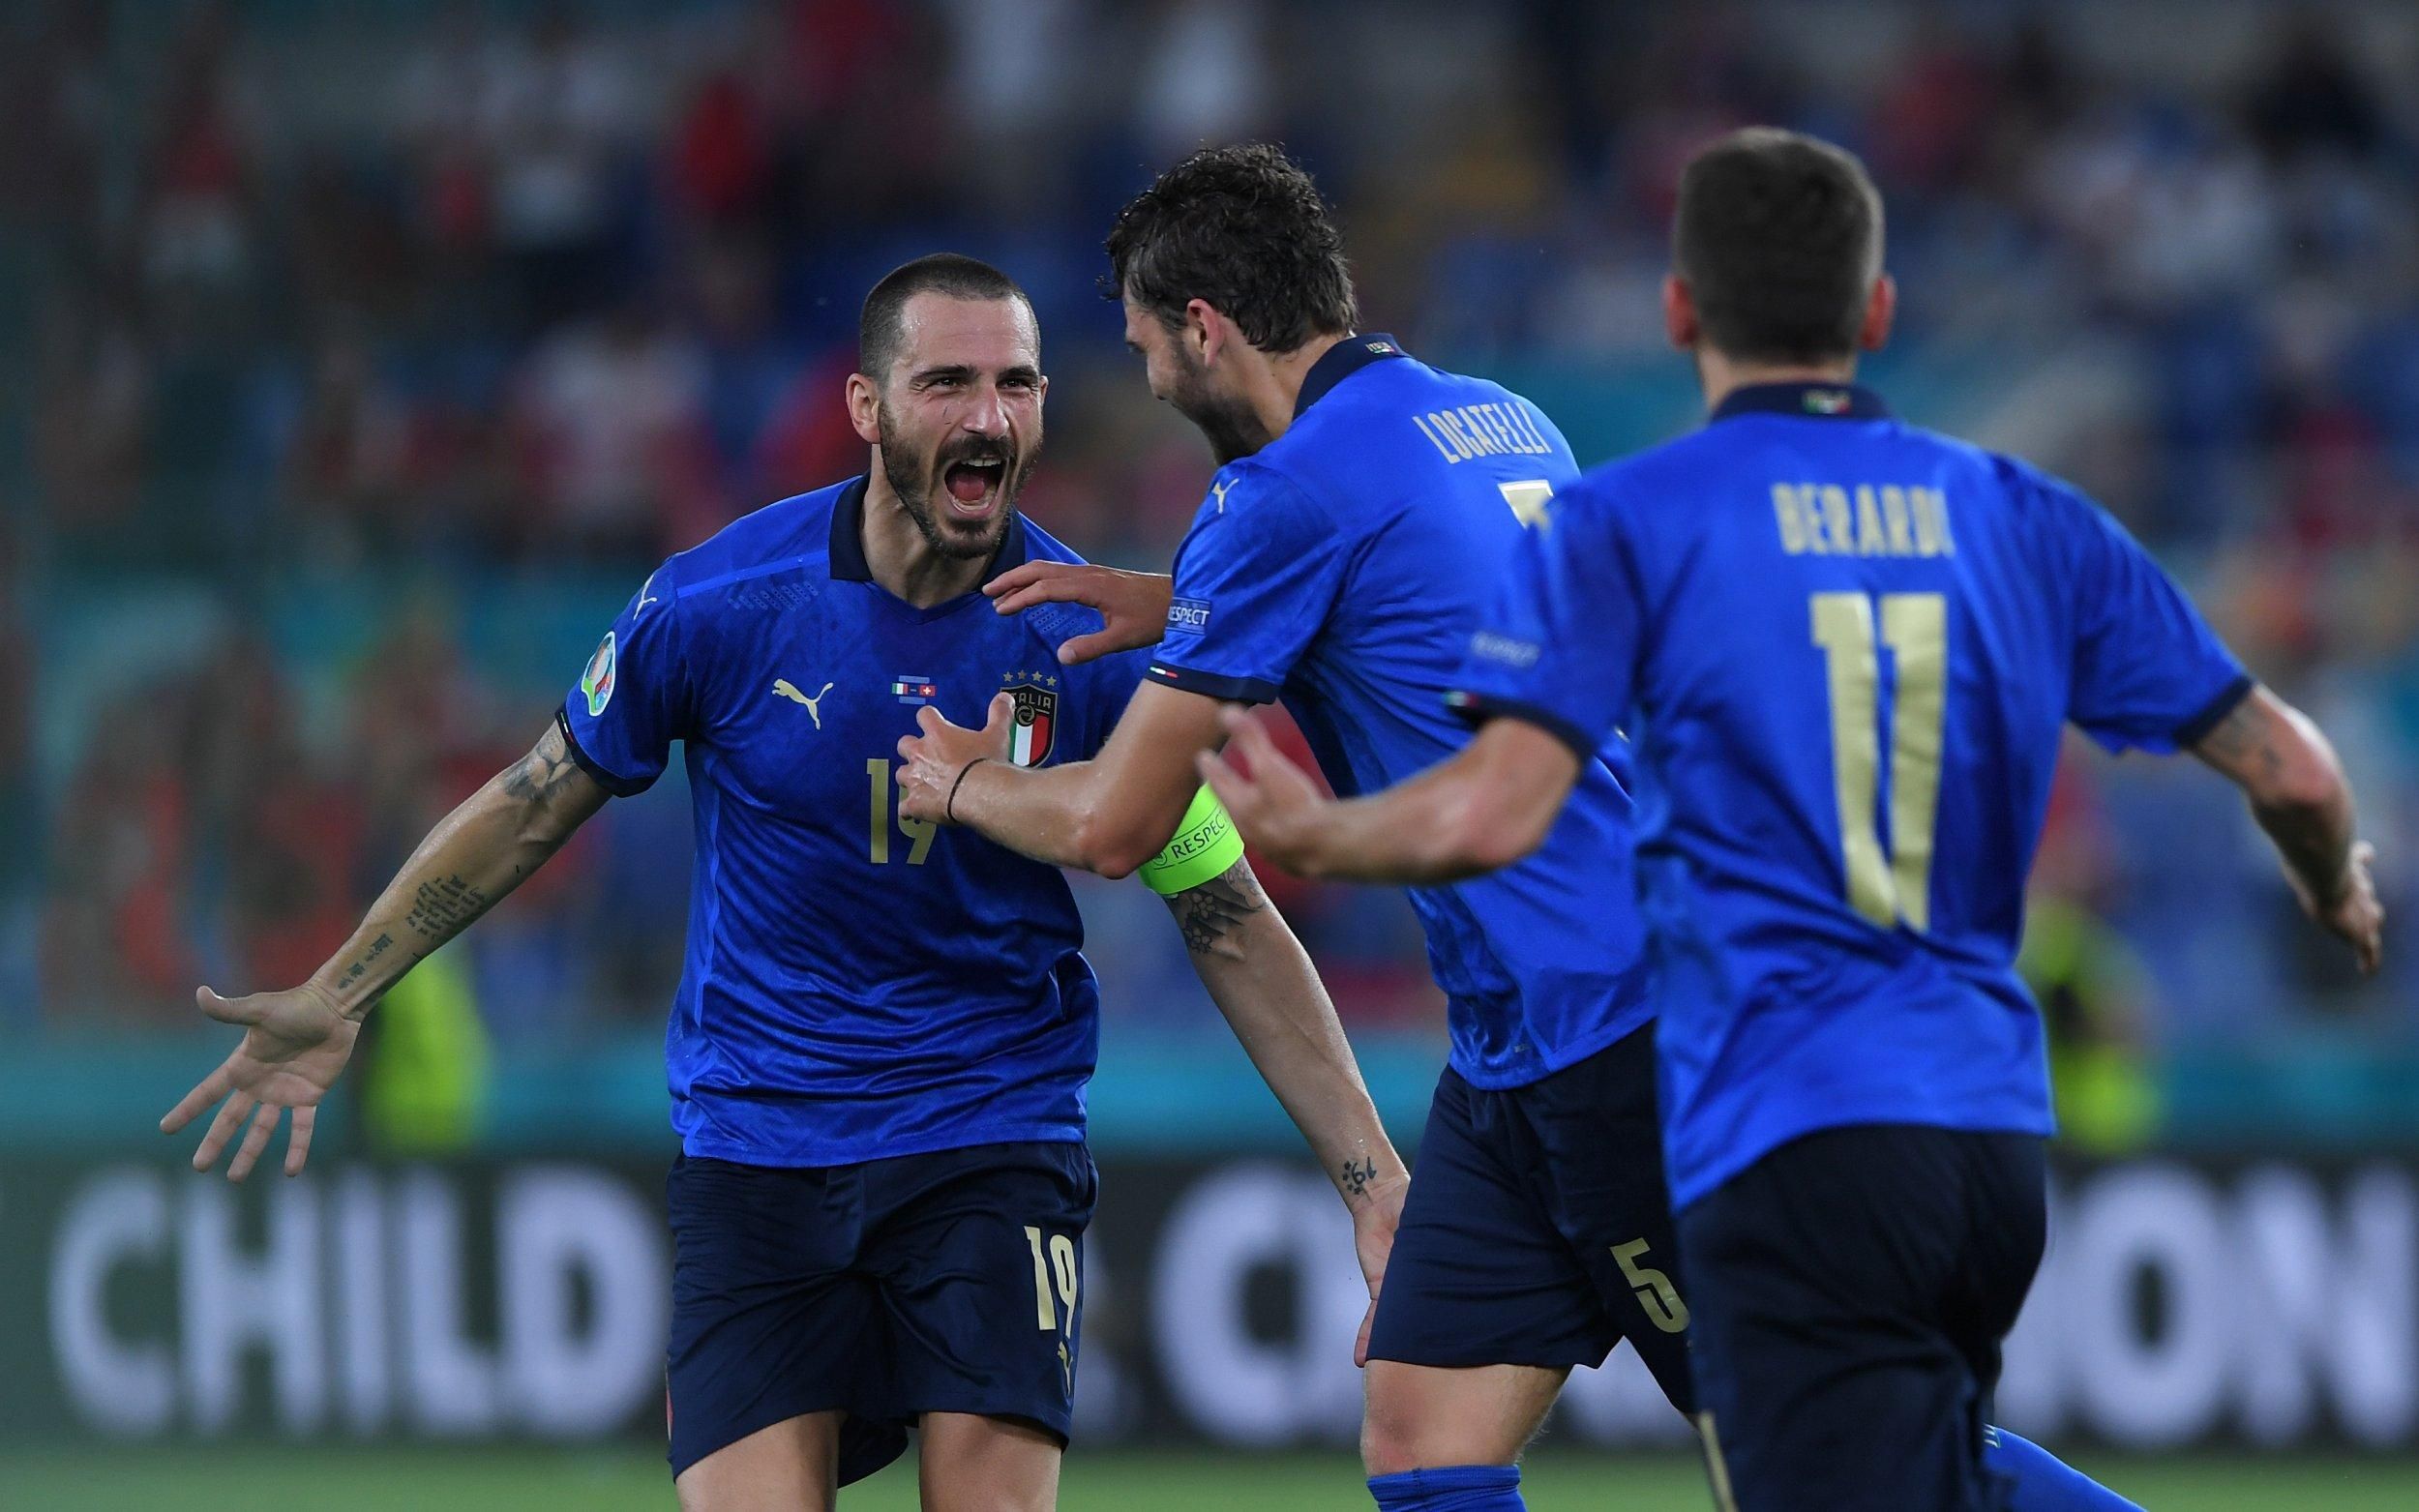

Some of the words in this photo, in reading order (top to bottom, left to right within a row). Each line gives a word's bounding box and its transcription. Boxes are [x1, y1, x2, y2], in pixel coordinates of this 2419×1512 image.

[1412, 401, 1553, 464] LOCATELLI
[1771, 482, 1956, 558] BERARDI
[1011, 693, 1052, 709] ALIA
[1808, 591, 1947, 932] 11
[49, 1164, 671, 1441] CHILD
[1024, 1226, 1078, 1340] 19
[1609, 1237, 1691, 1333] 5
